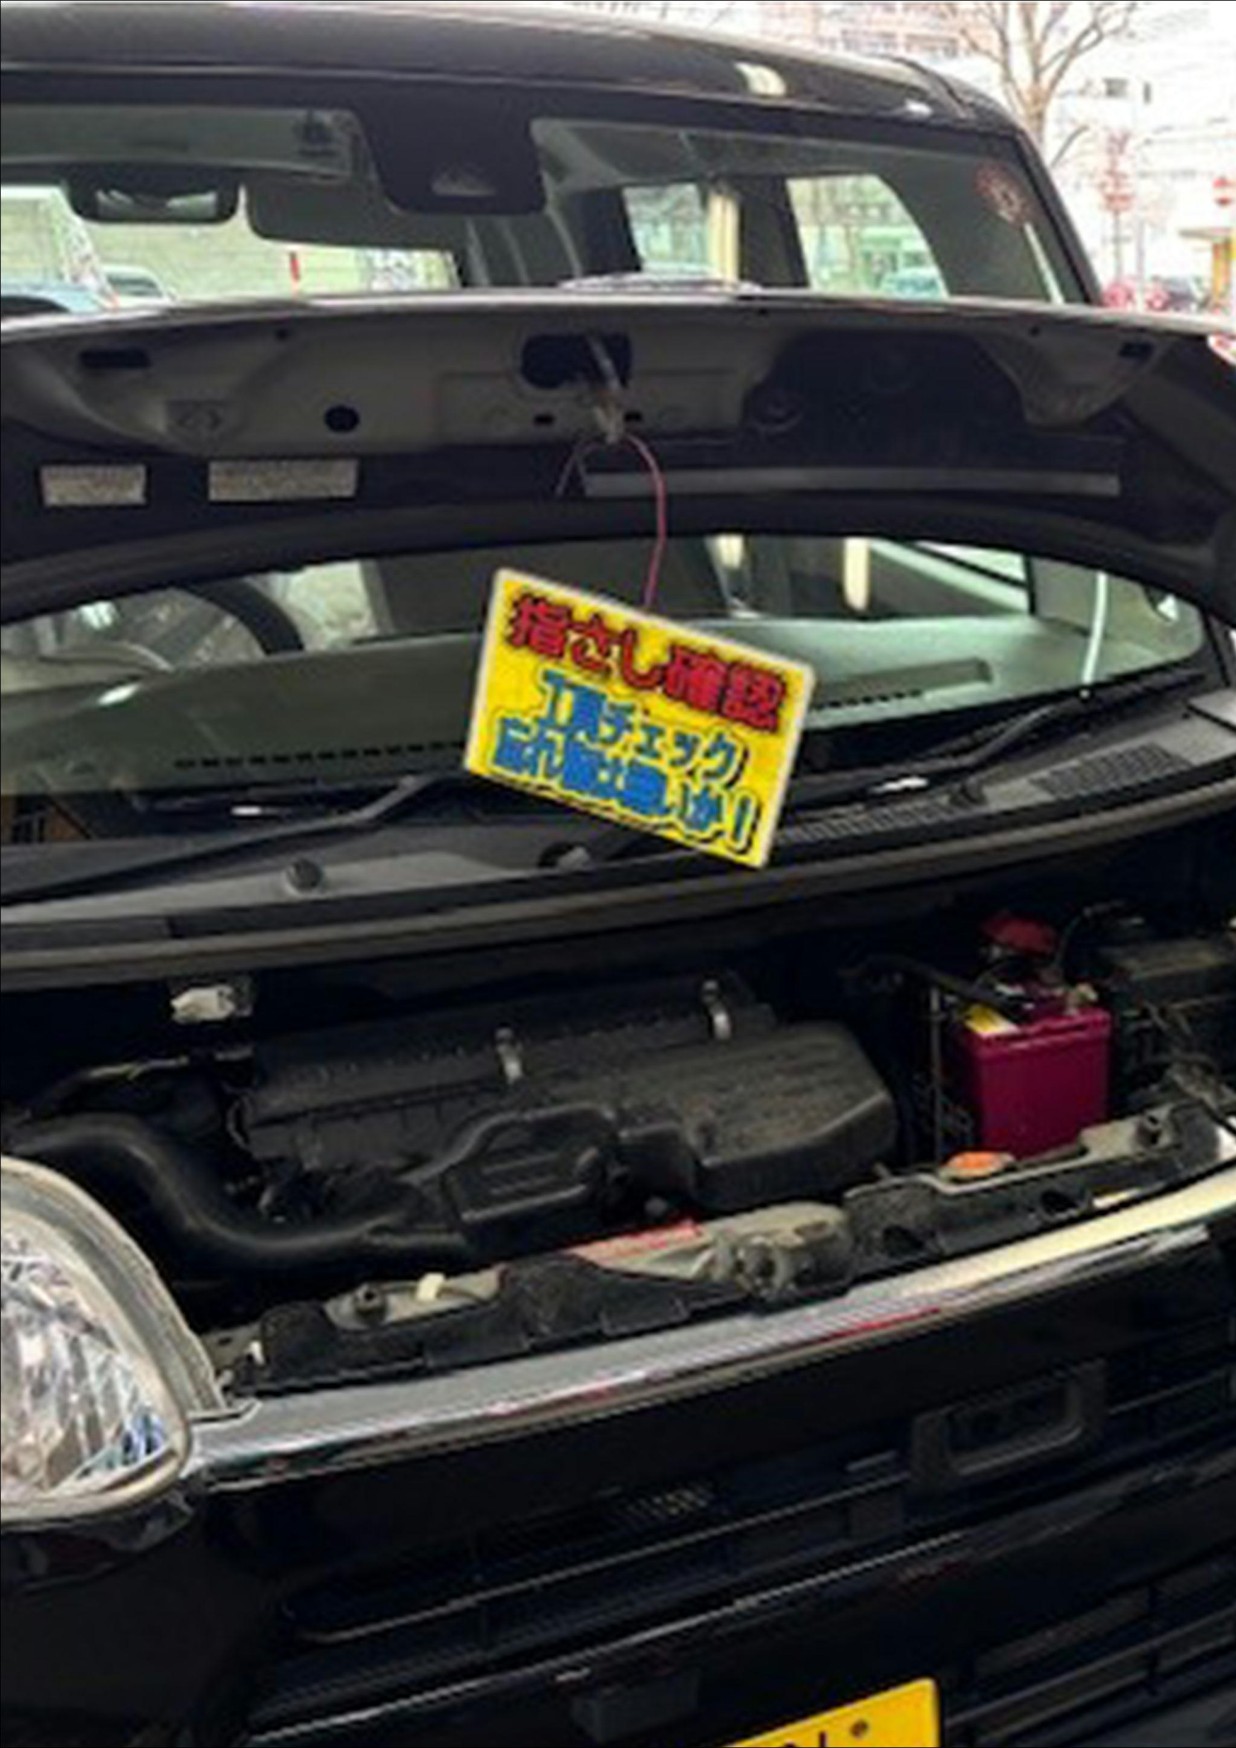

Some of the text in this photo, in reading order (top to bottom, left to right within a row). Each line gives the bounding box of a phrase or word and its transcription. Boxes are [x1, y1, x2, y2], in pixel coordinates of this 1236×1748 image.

[506, 593, 787, 731] 指さし確認
